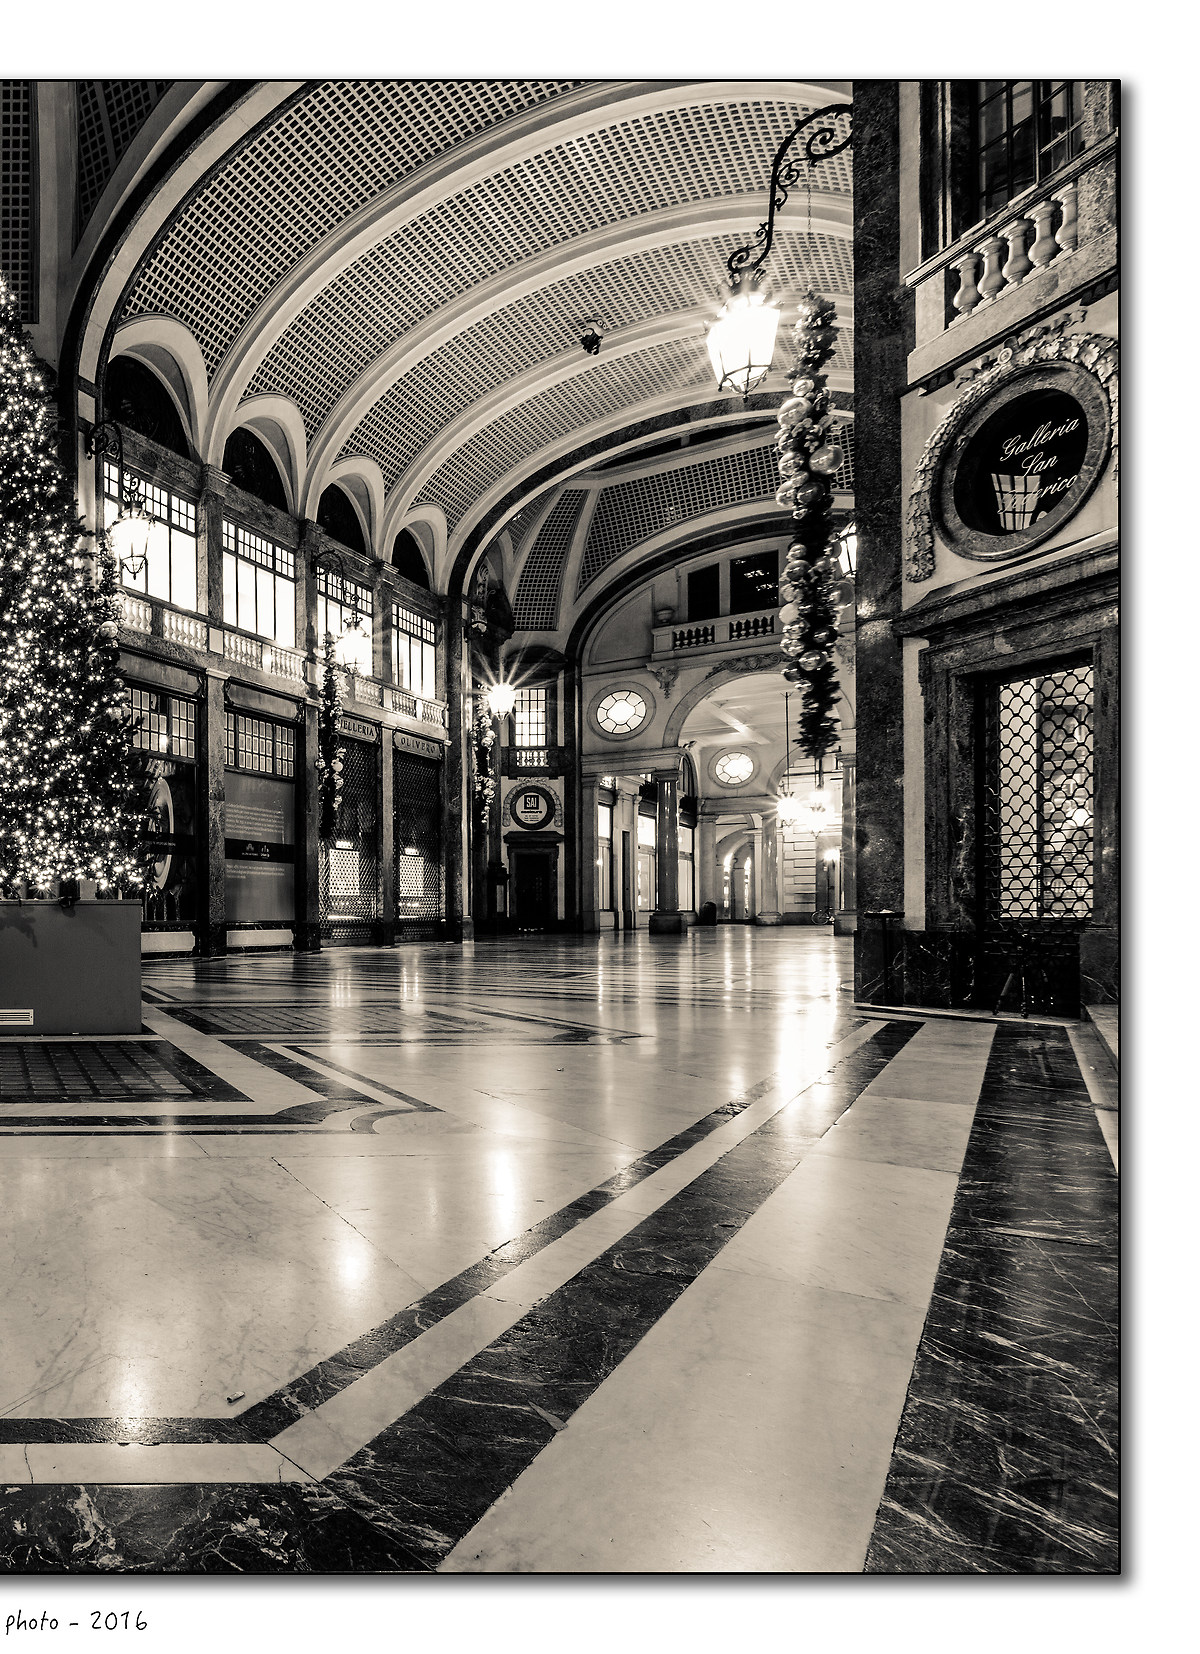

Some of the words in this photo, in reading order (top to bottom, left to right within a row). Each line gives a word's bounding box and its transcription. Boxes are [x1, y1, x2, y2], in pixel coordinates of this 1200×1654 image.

[1000, 418, 1080, 461] Galleria
[1021, 452, 1058, 477] San
[400, 736, 436, 754] OLIVERO
[526, 797, 537, 808] SAI
